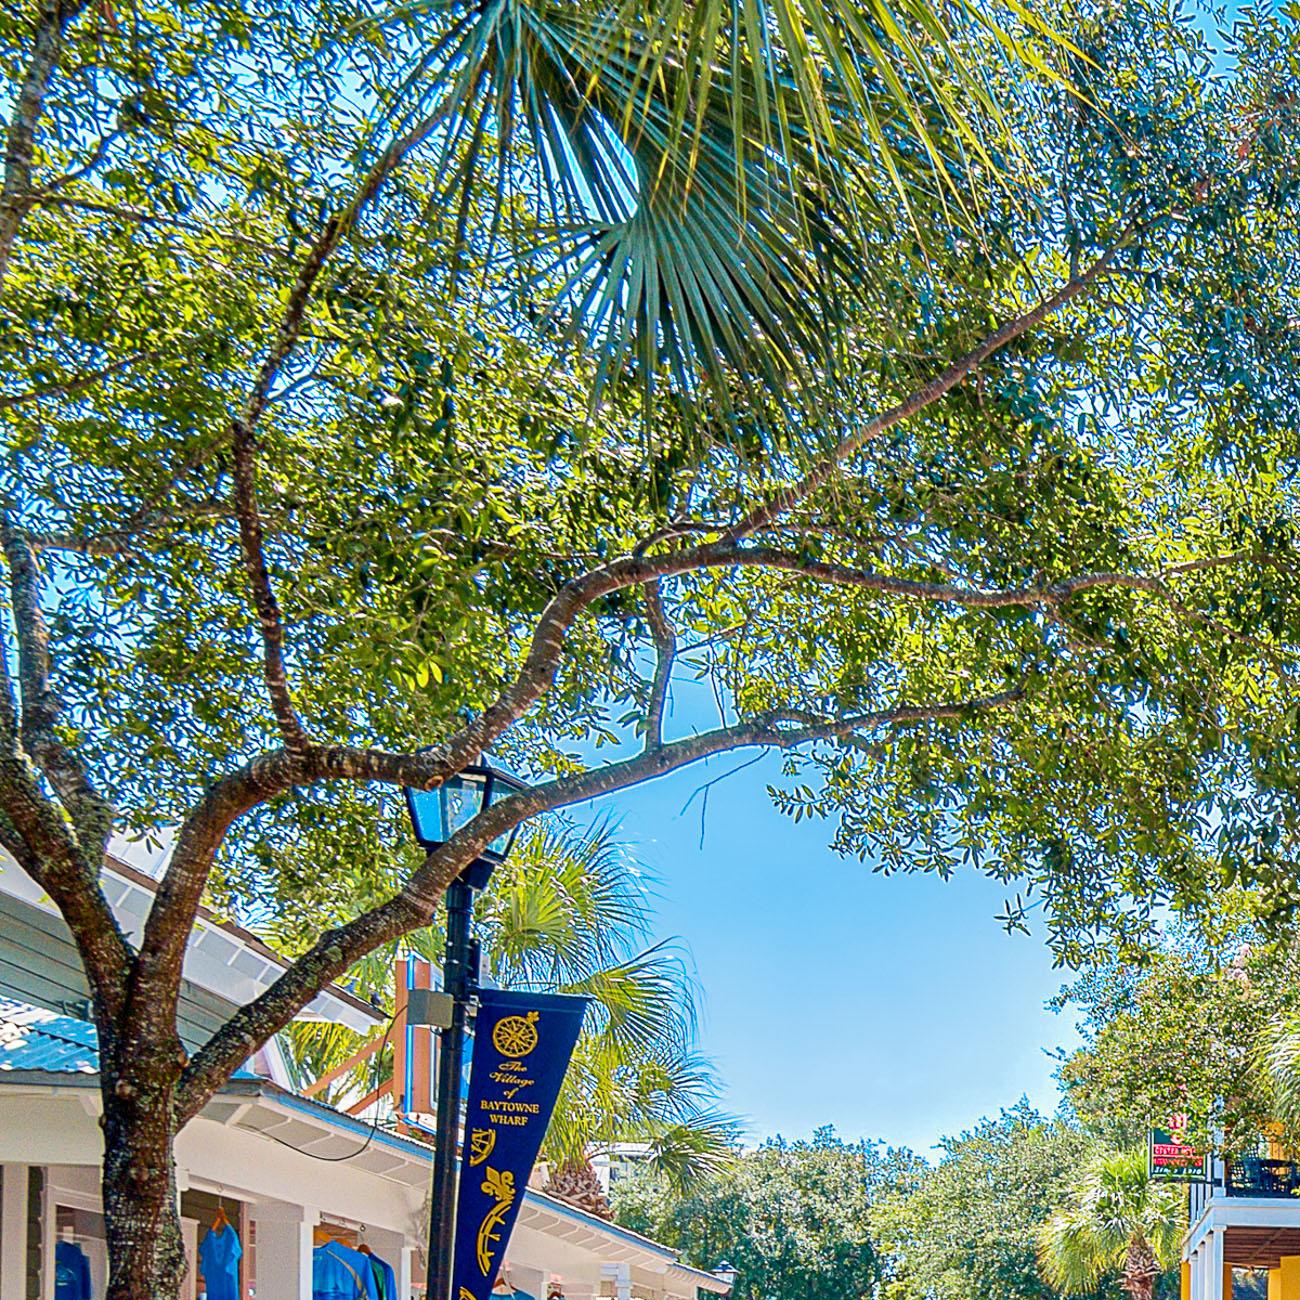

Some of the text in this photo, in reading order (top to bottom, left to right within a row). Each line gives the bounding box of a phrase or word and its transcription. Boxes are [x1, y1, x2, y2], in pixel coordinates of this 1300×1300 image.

[499, 1061, 527, 1072] The
[489, 1071, 534, 1086] Village
[503, 1088, 519, 1099] of
[480, 1100, 540, 1114] BAYTOWNE
[489, 1114, 528, 1126] WHARF
